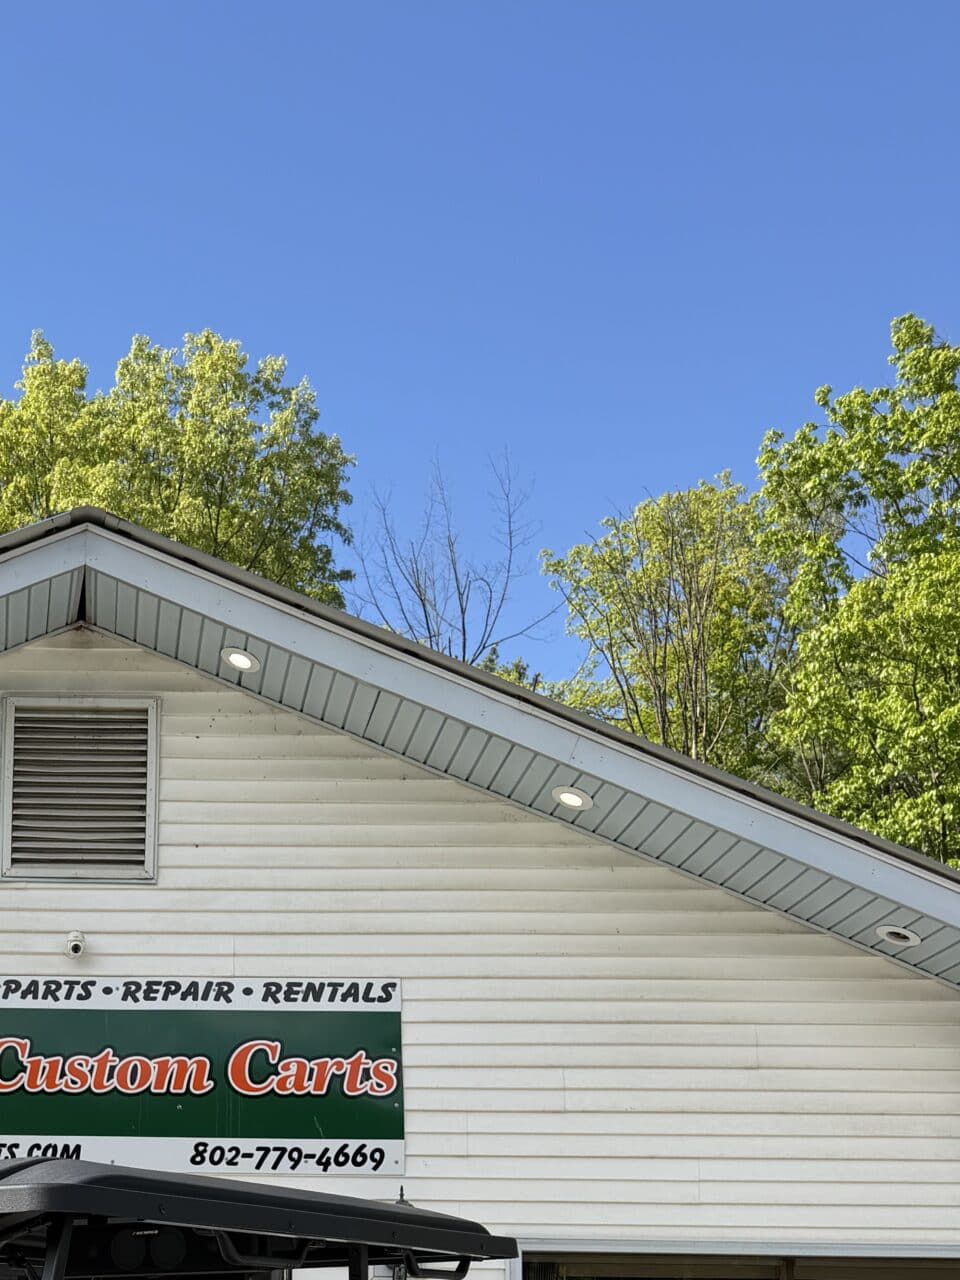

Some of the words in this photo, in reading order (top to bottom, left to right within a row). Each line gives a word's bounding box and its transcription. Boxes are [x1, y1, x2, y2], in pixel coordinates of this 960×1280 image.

[1, 979, 96, 1002] PARTS
[121, 980, 235, 1004] REPAIR
[261, 981, 398, 1004] RENTALS
[228, 1040, 398, 1096] Carts
[189, 1141, 386, 1173] 802-779-4669
